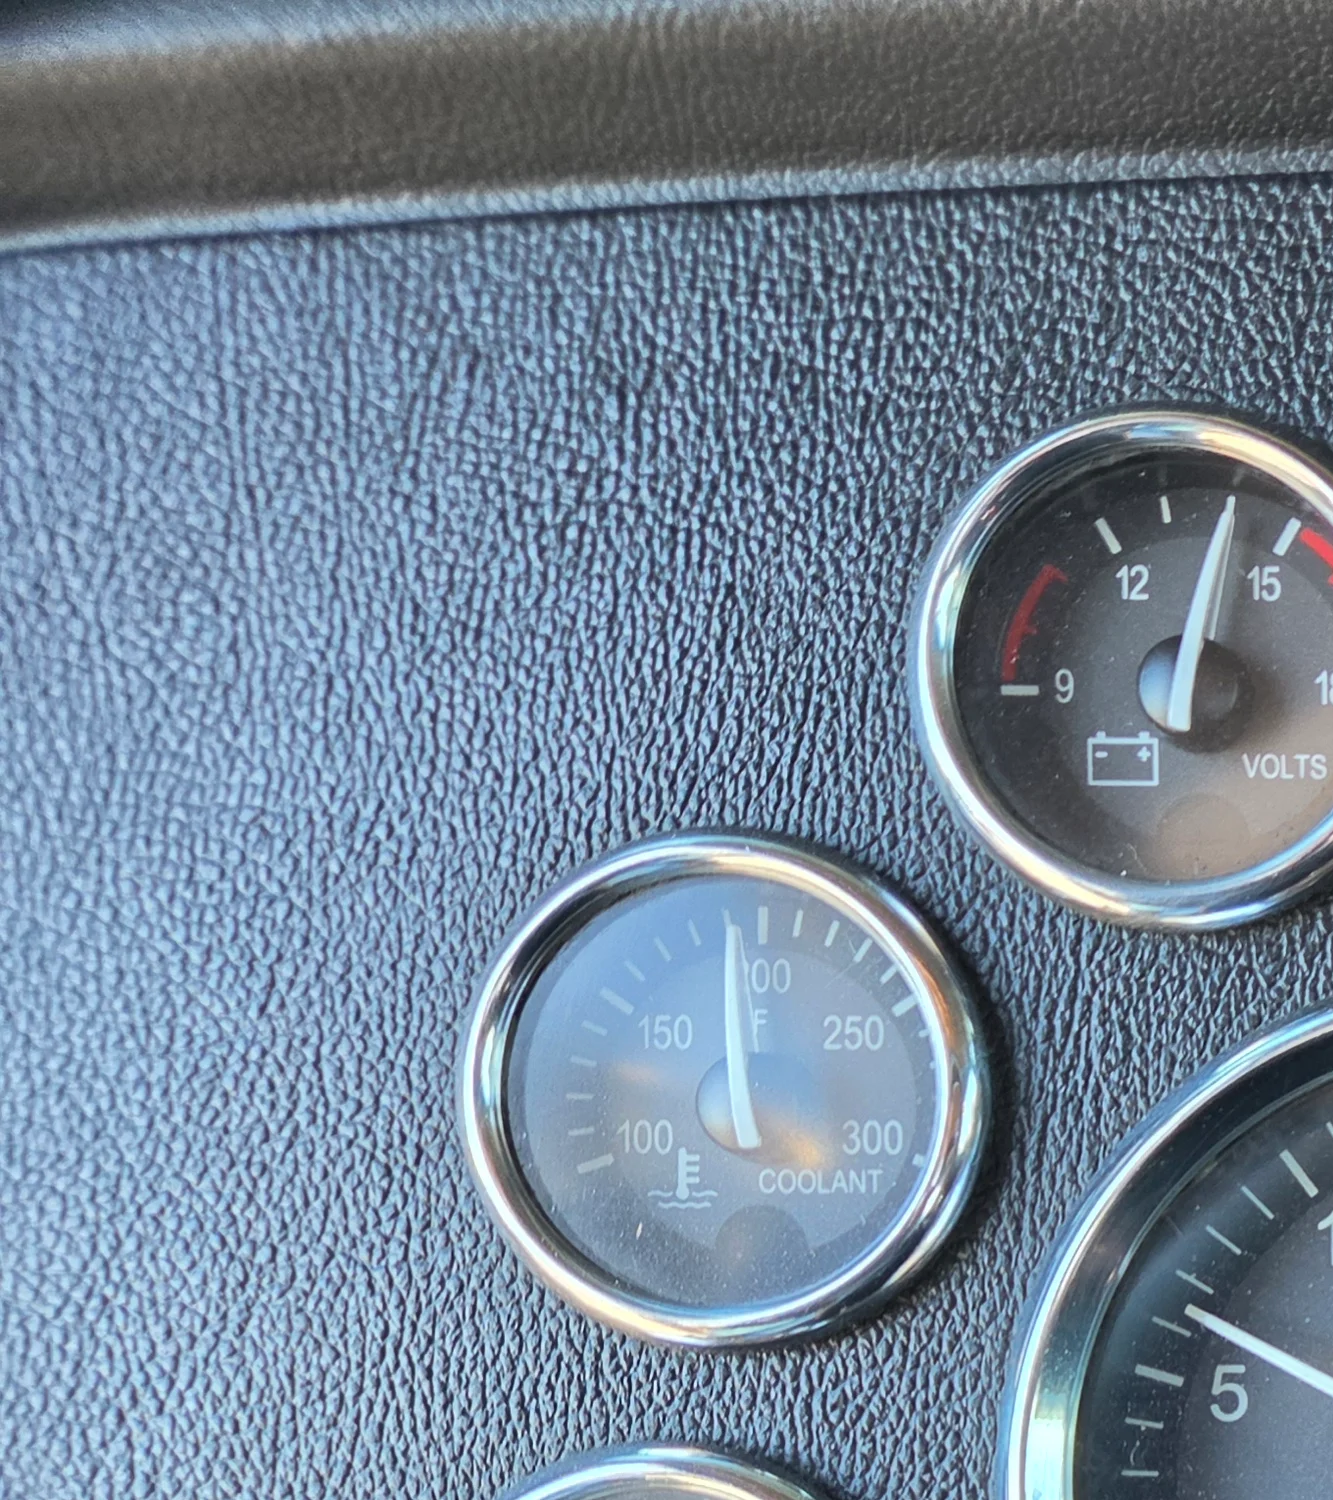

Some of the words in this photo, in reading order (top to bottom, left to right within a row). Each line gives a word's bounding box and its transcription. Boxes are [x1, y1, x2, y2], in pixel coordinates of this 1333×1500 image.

[1115, 565, 1150, 601] 12
[1246, 565, 1282, 601] 15
[1054, 669, 1075, 703] 9
[1242, 753, 1327, 780] VOLTS
[742, 958, 791, 994] 00
[638, 1014, 692, 1051] 150
[823, 1015, 884, 1051] 250
[616, 1119, 674, 1155] 100
[842, 1120, 903, 1156] 300
[758, 1168, 883, 1195] COOLANT
[1209, 1366, 1248, 1423] 5
